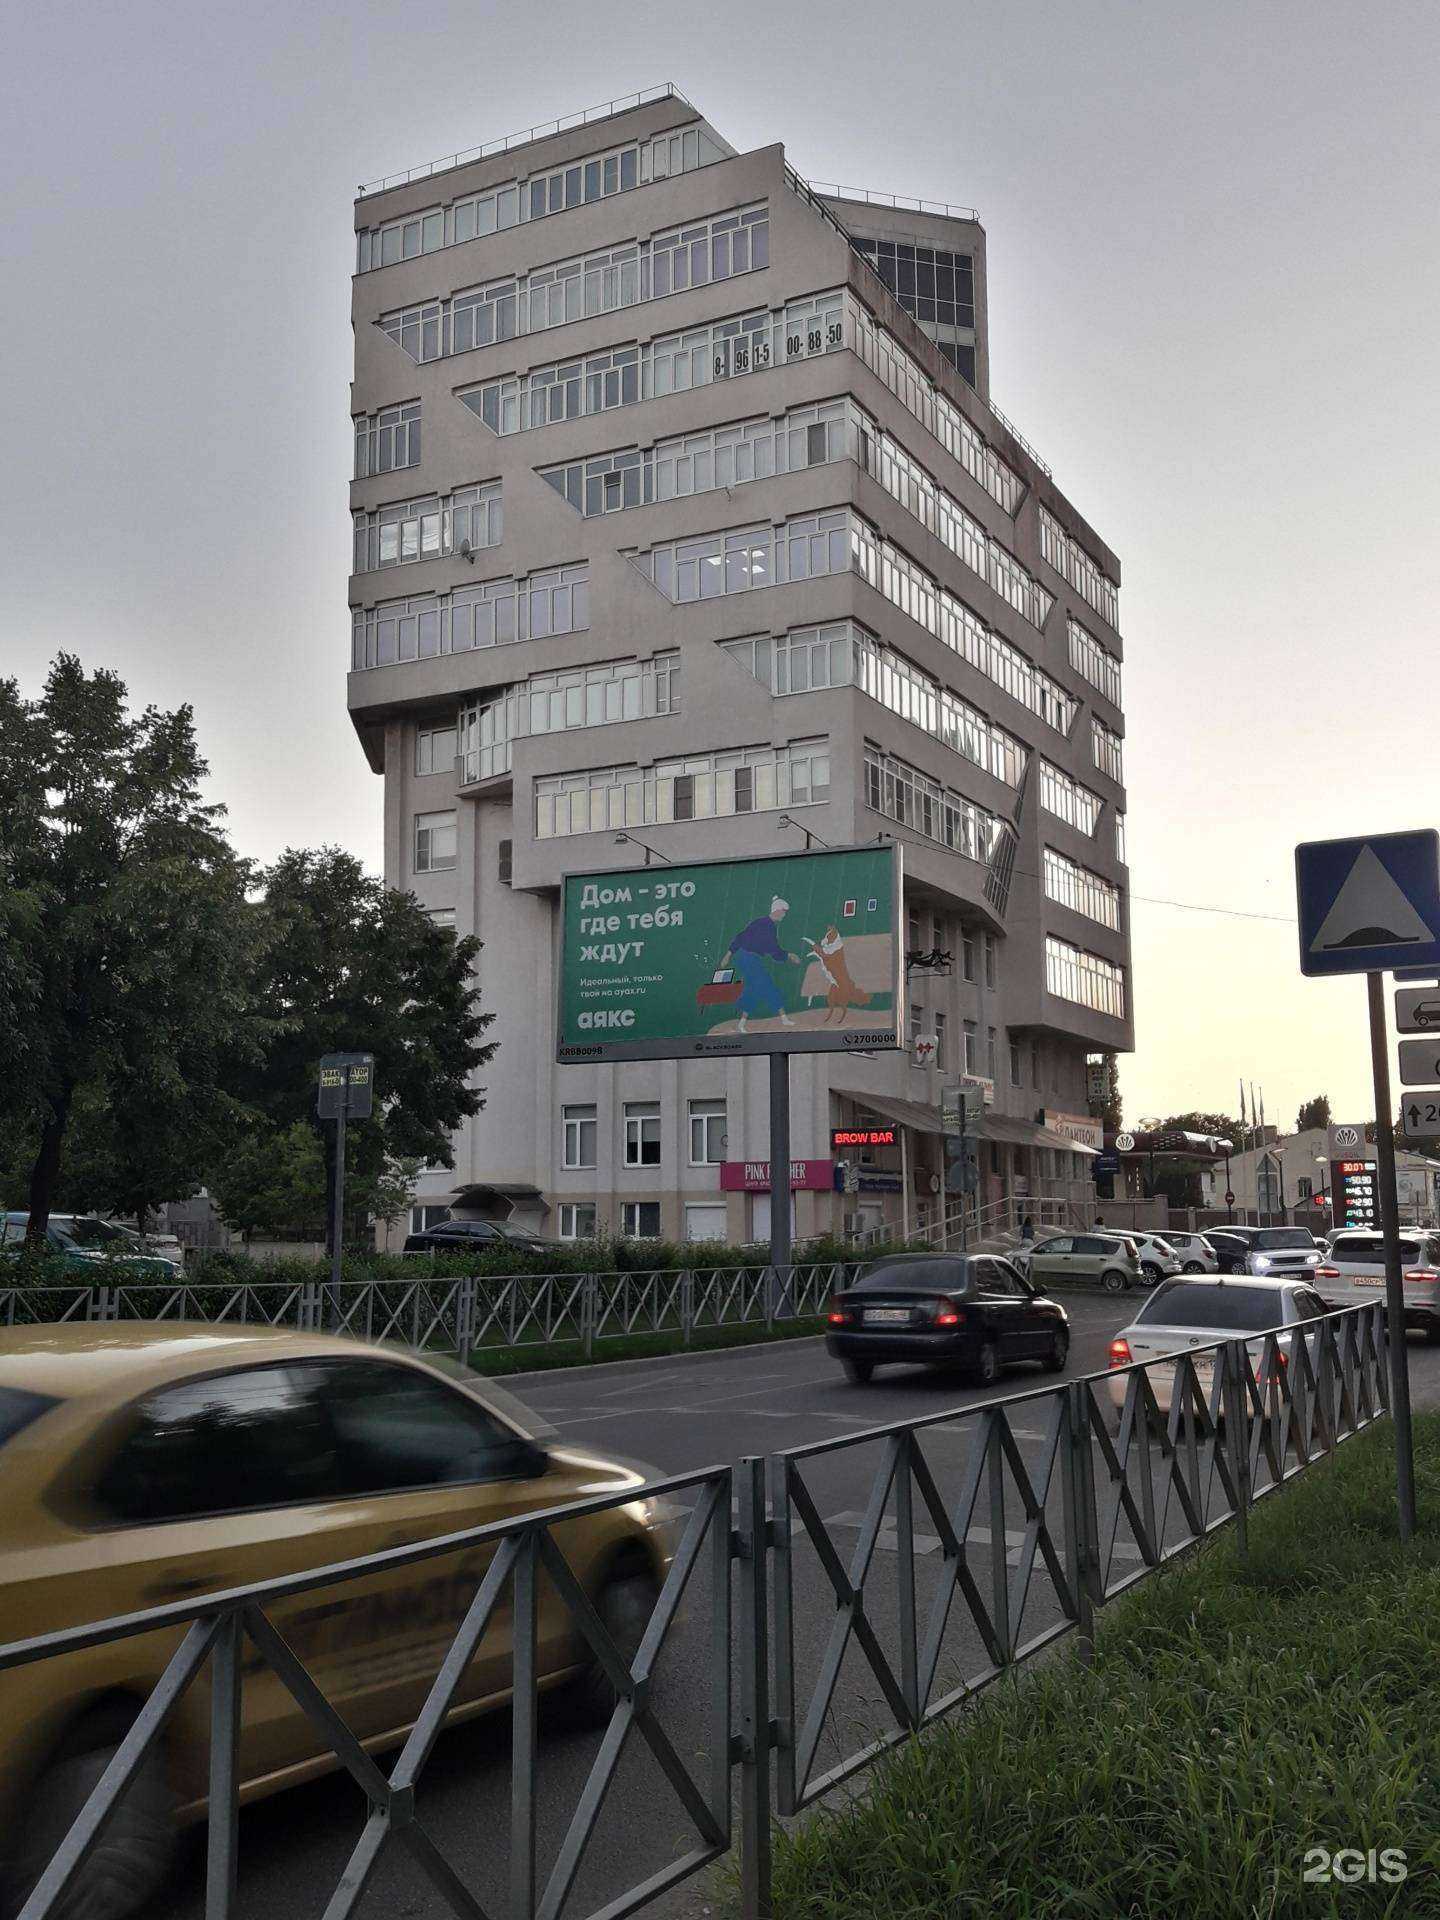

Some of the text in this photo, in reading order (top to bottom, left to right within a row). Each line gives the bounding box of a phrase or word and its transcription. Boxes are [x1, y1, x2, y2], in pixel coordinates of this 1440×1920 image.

[580, 884, 632, 909] Дом
[654, 881, 696, 900] это
[580, 904, 684, 935] где тебя
[579, 941, 645, 964] ждут
[577, 1009, 635, 1029] аякс
[834, 1132, 894, 1143] BROW BAR
[745, 1163, 765, 1180] PINK
